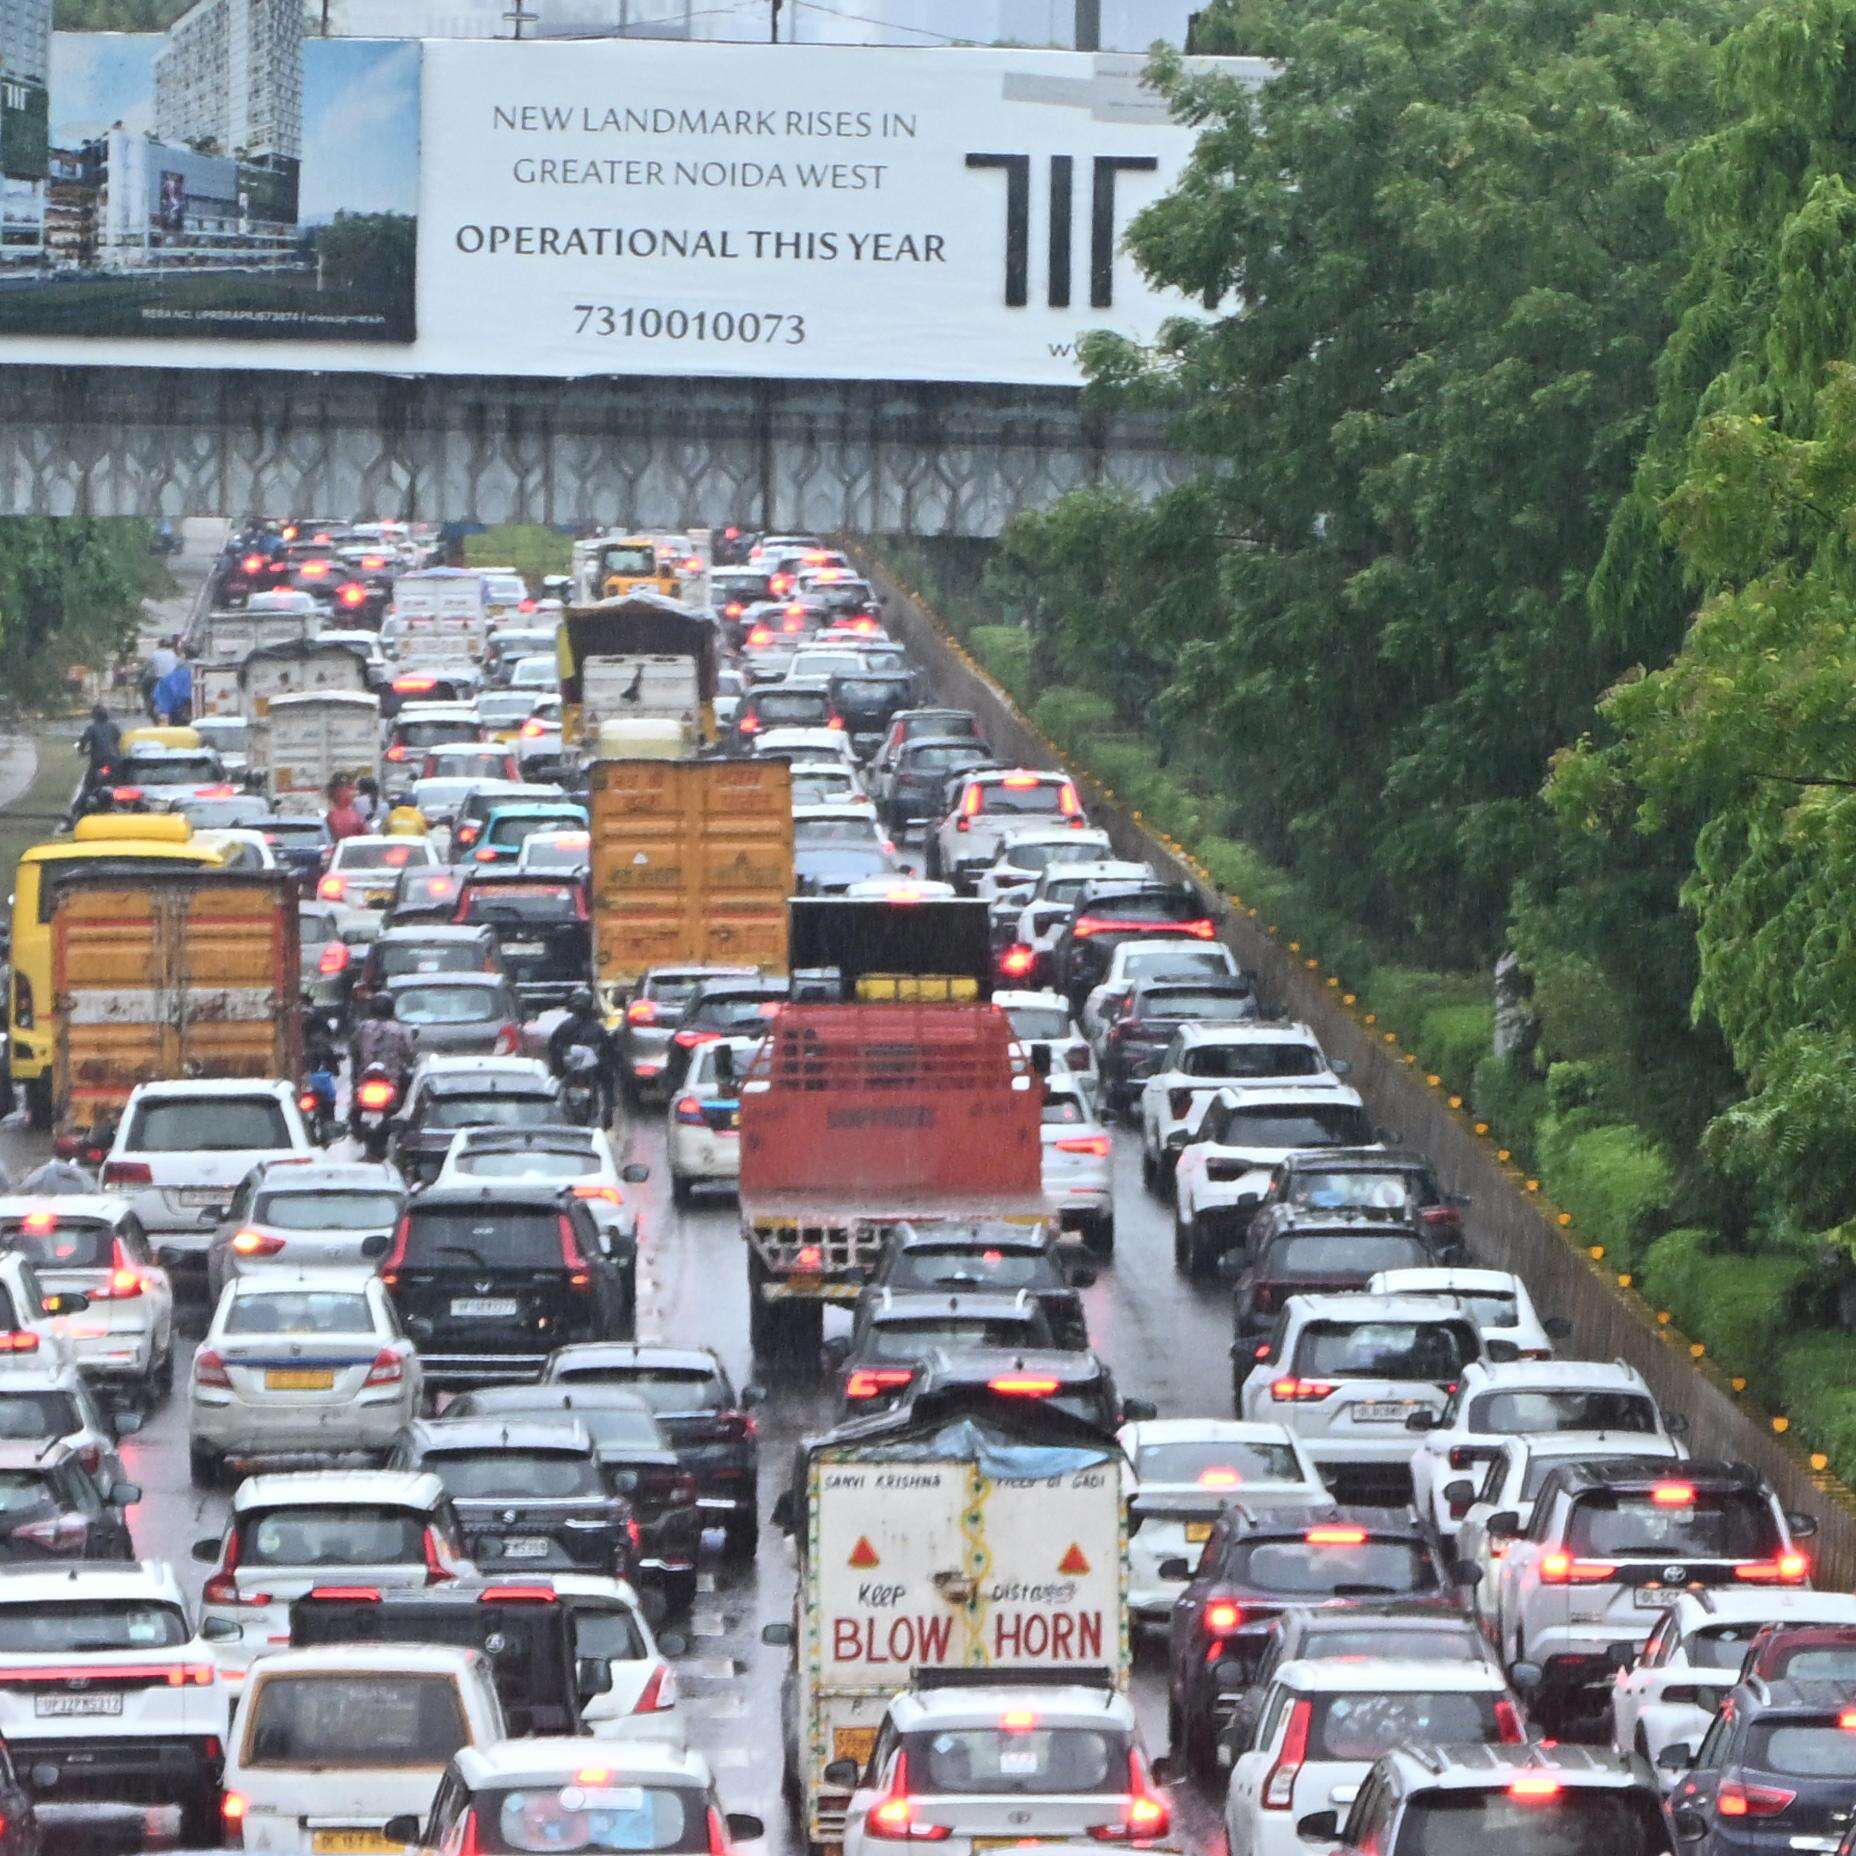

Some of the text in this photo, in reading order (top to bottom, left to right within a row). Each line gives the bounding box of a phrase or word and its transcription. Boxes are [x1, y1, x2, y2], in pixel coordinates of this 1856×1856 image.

[493, 105, 917, 138] NEW LANDMARK RISES IN
[514, 158, 888, 190] GREATER NOIDA WEST
[456, 225, 947, 262] OPERATIONAL THIS YEAR
[574, 304, 806, 345] 7310010073
[833, 1611, 1103, 1663] BLOW HORN
